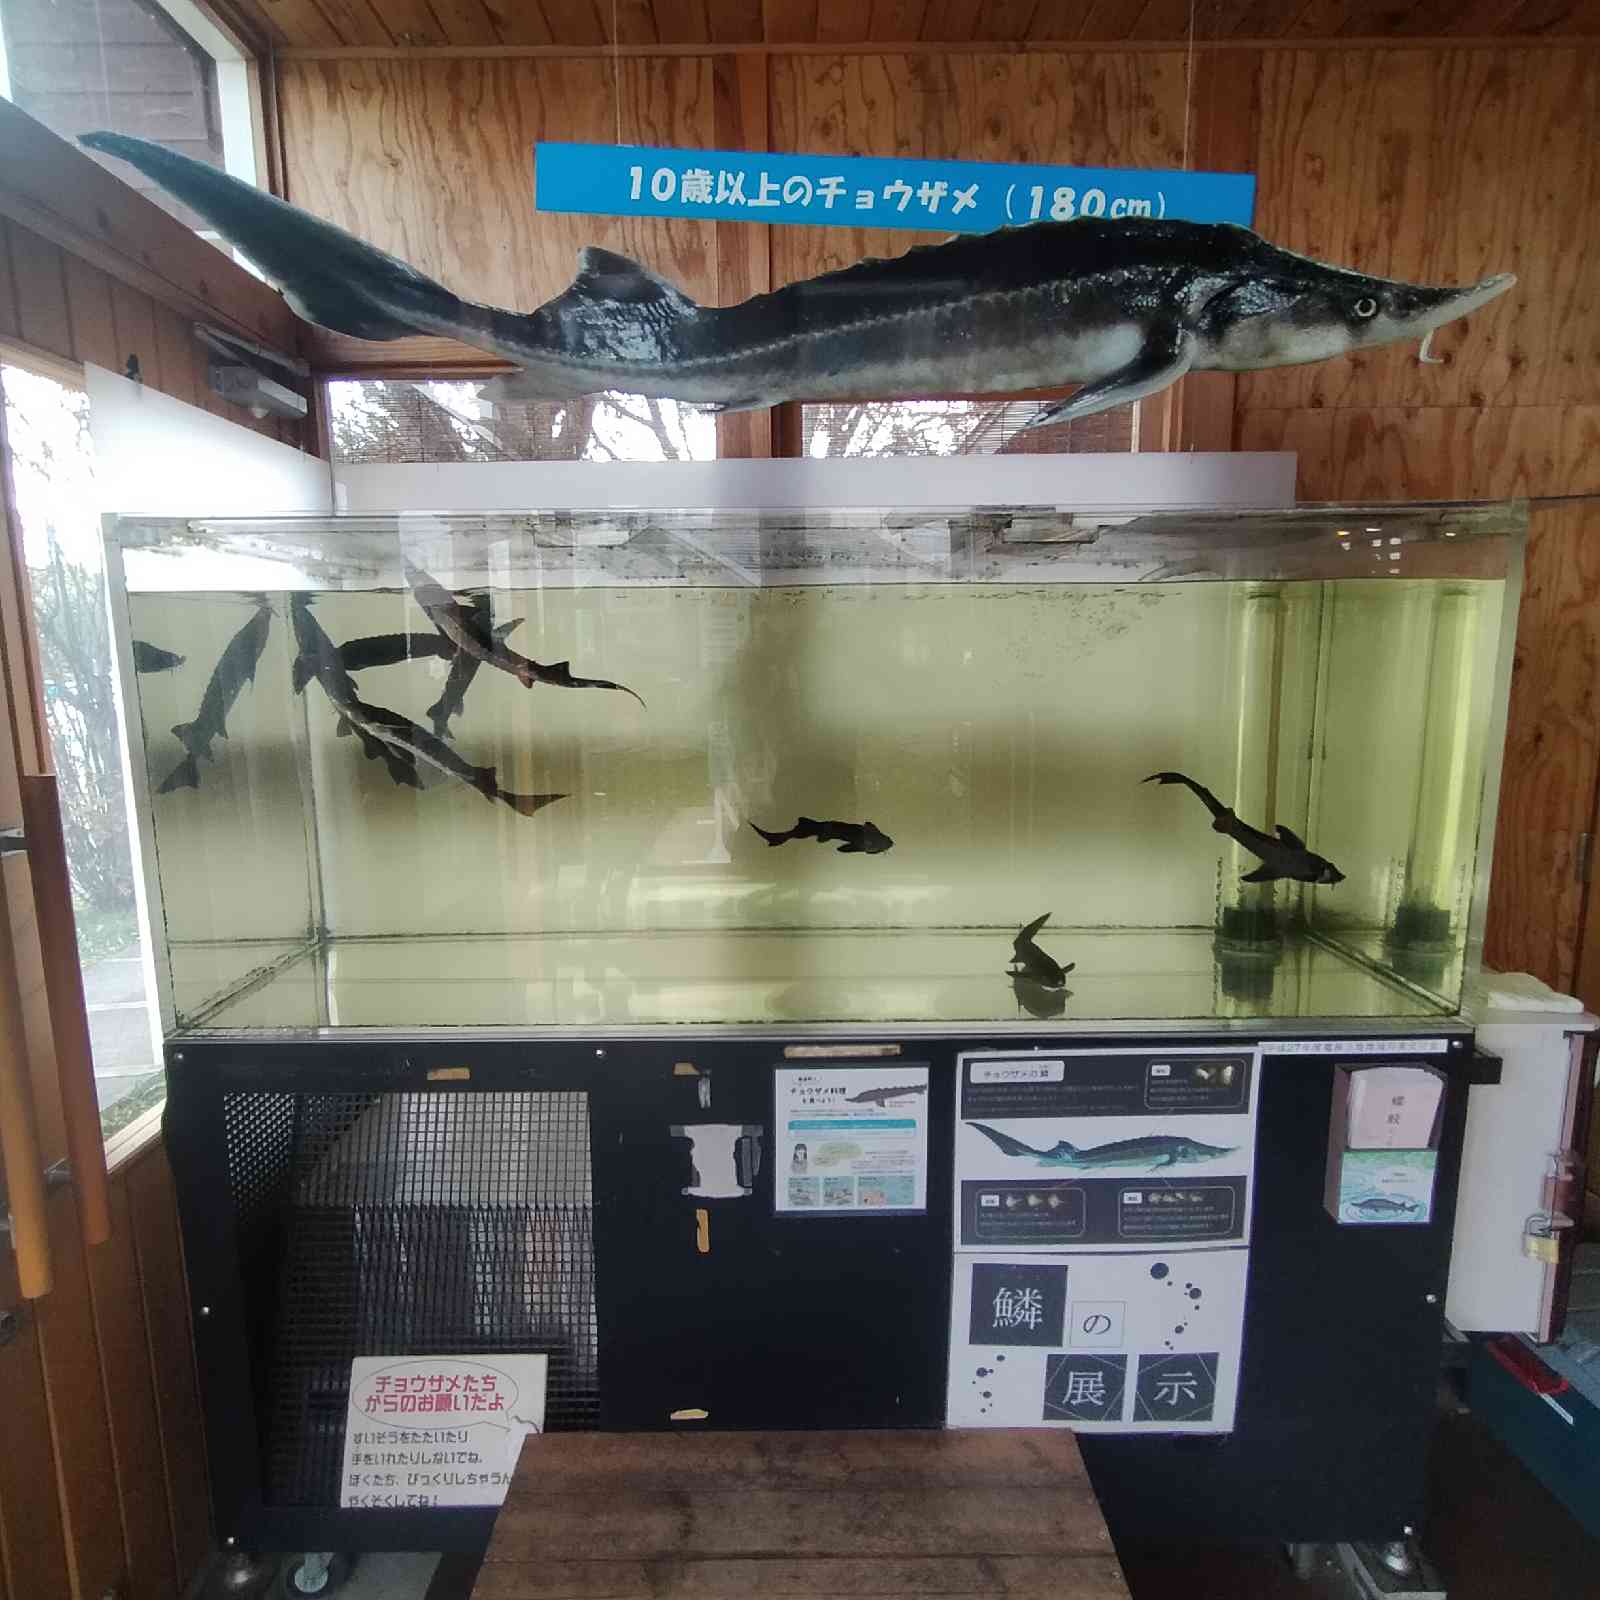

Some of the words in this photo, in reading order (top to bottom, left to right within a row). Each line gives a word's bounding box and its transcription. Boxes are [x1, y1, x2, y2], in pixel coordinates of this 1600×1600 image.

[630, 166, 980, 215] 10歳以上のチョウザメ
[375, 1374, 497, 1393] チョウザメたち
[353, 1431, 469, 1445] すいそうをたたいたり
